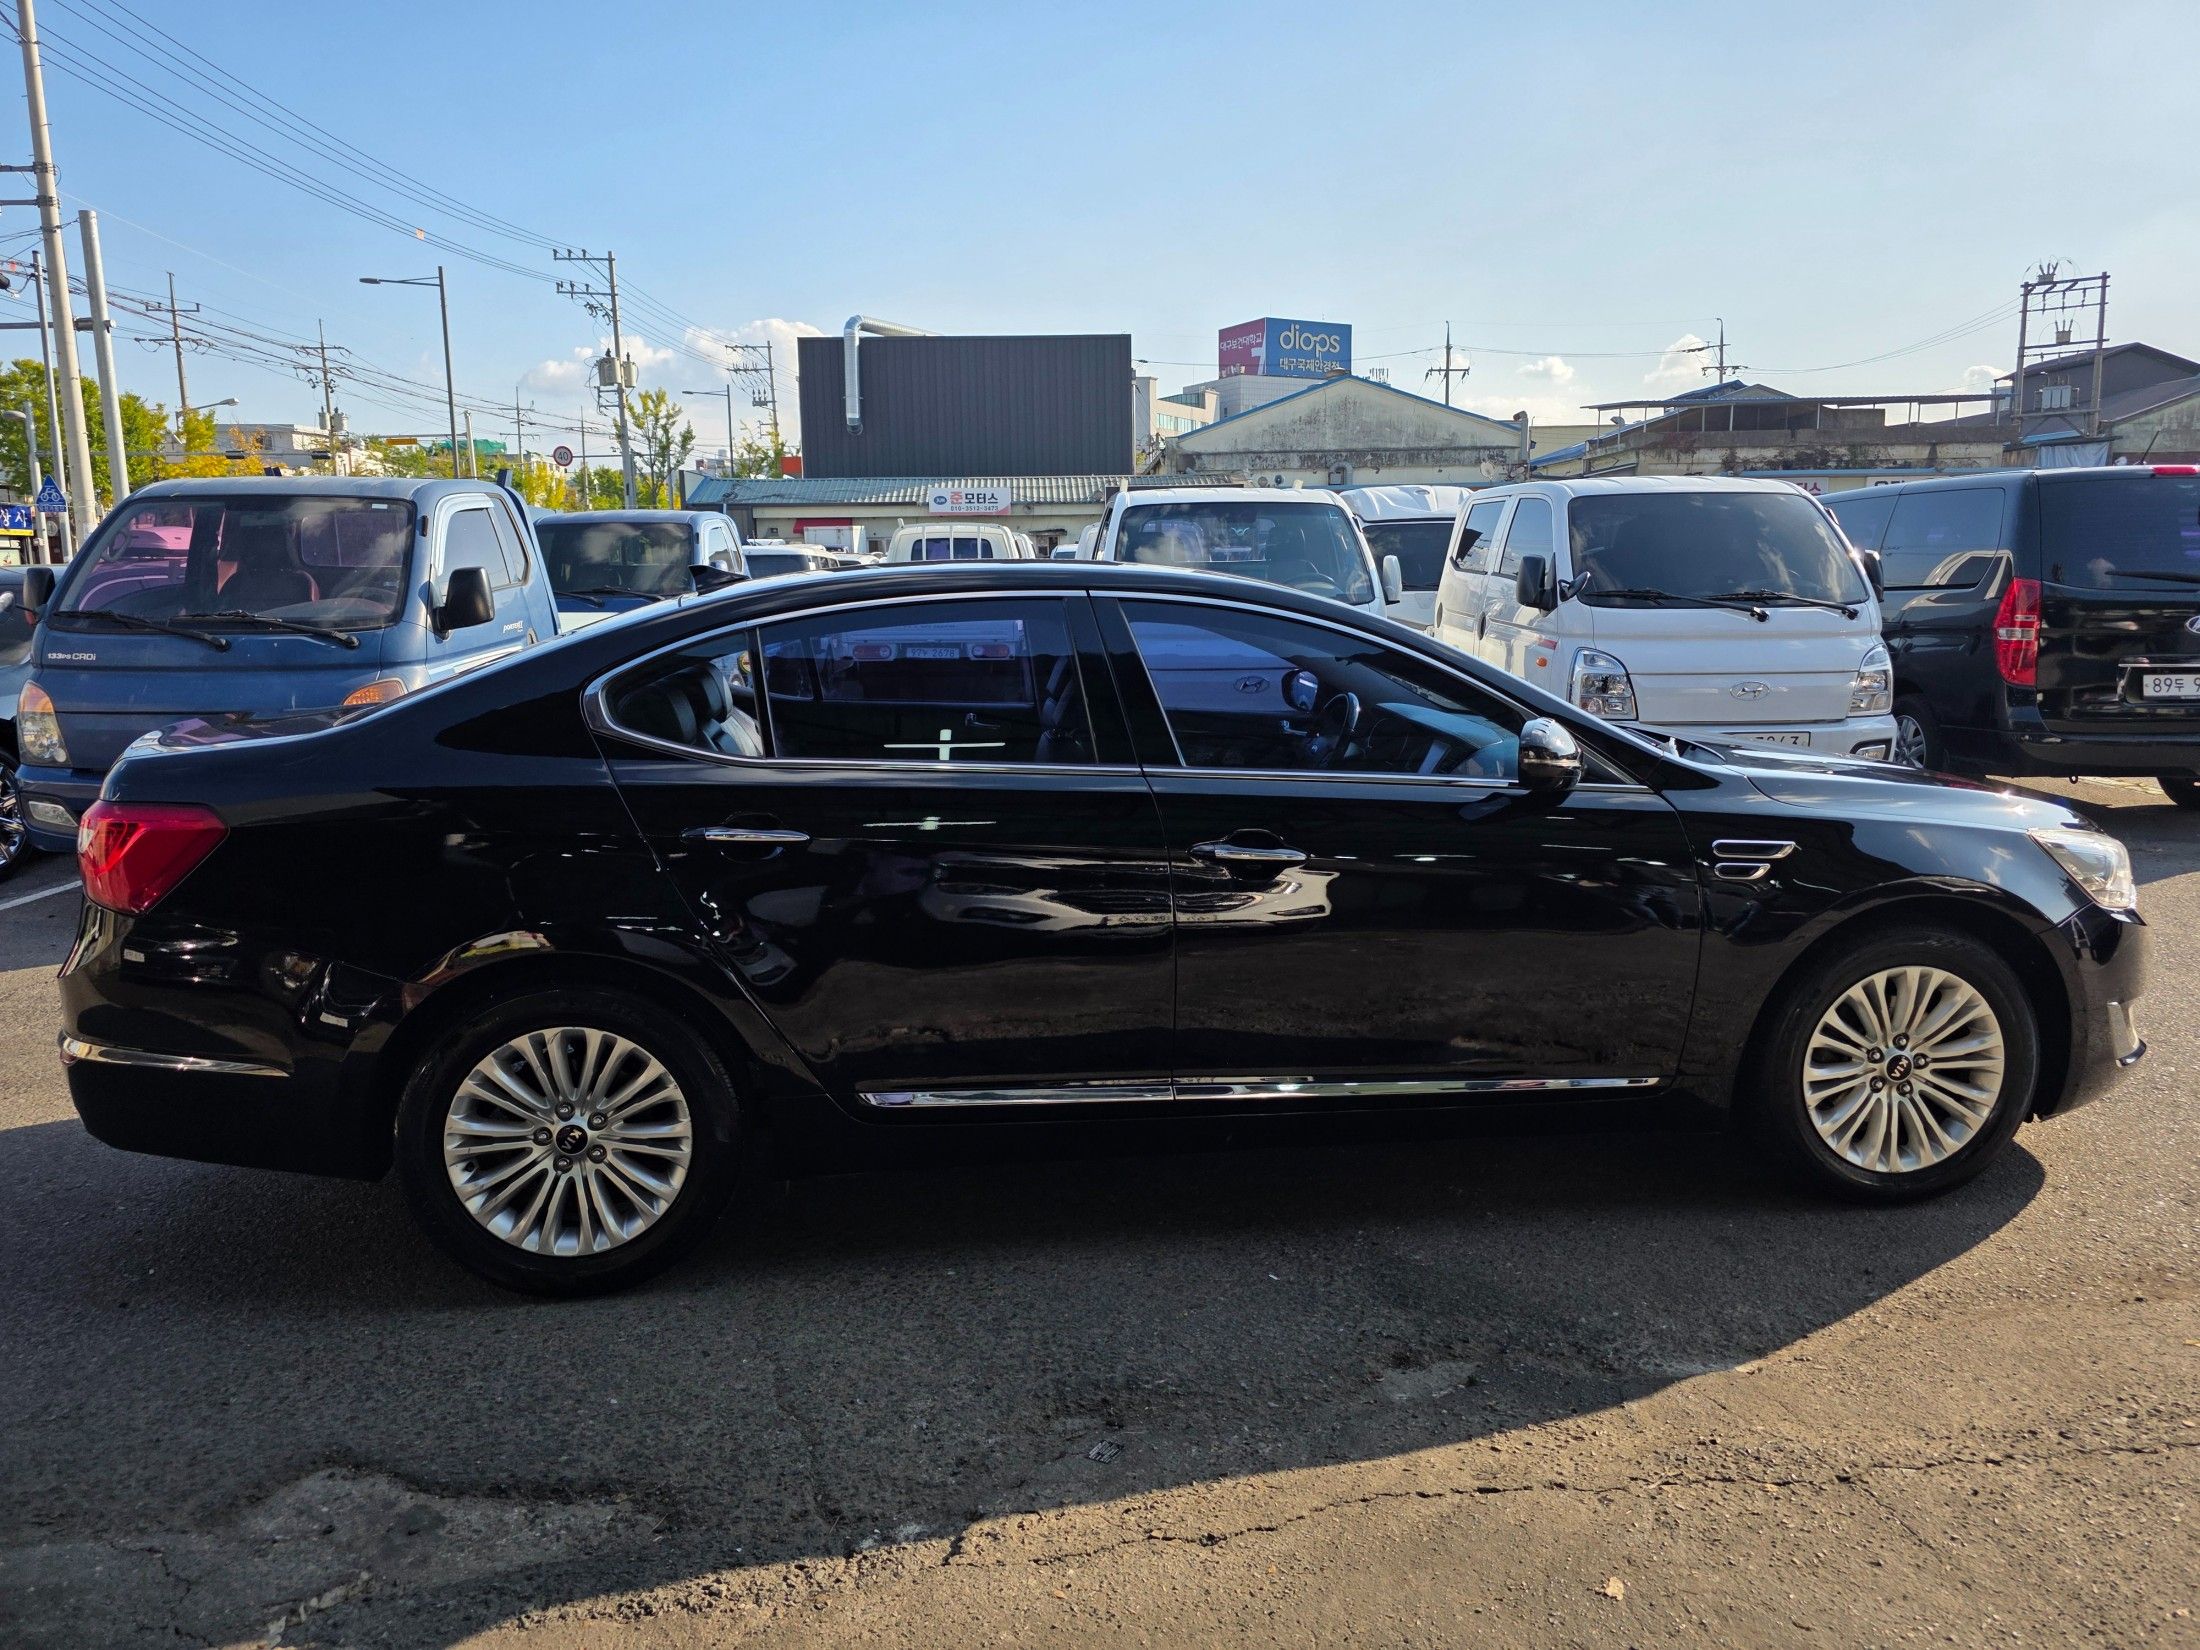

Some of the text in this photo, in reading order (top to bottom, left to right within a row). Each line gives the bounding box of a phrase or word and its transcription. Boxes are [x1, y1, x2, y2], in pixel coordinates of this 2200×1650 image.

[1280, 324, 1340, 358] diops
[557, 451, 569, 460] 40
[950, 491, 999, 504] 준모터스
[0, 508, 28, 528] 상사
[72, 653, 96, 661] CRDi
[2153, 677, 2185, 693] 89두
[1891, 1057, 1909, 1078] KIA
[562, 1129, 583, 1150] KIA
